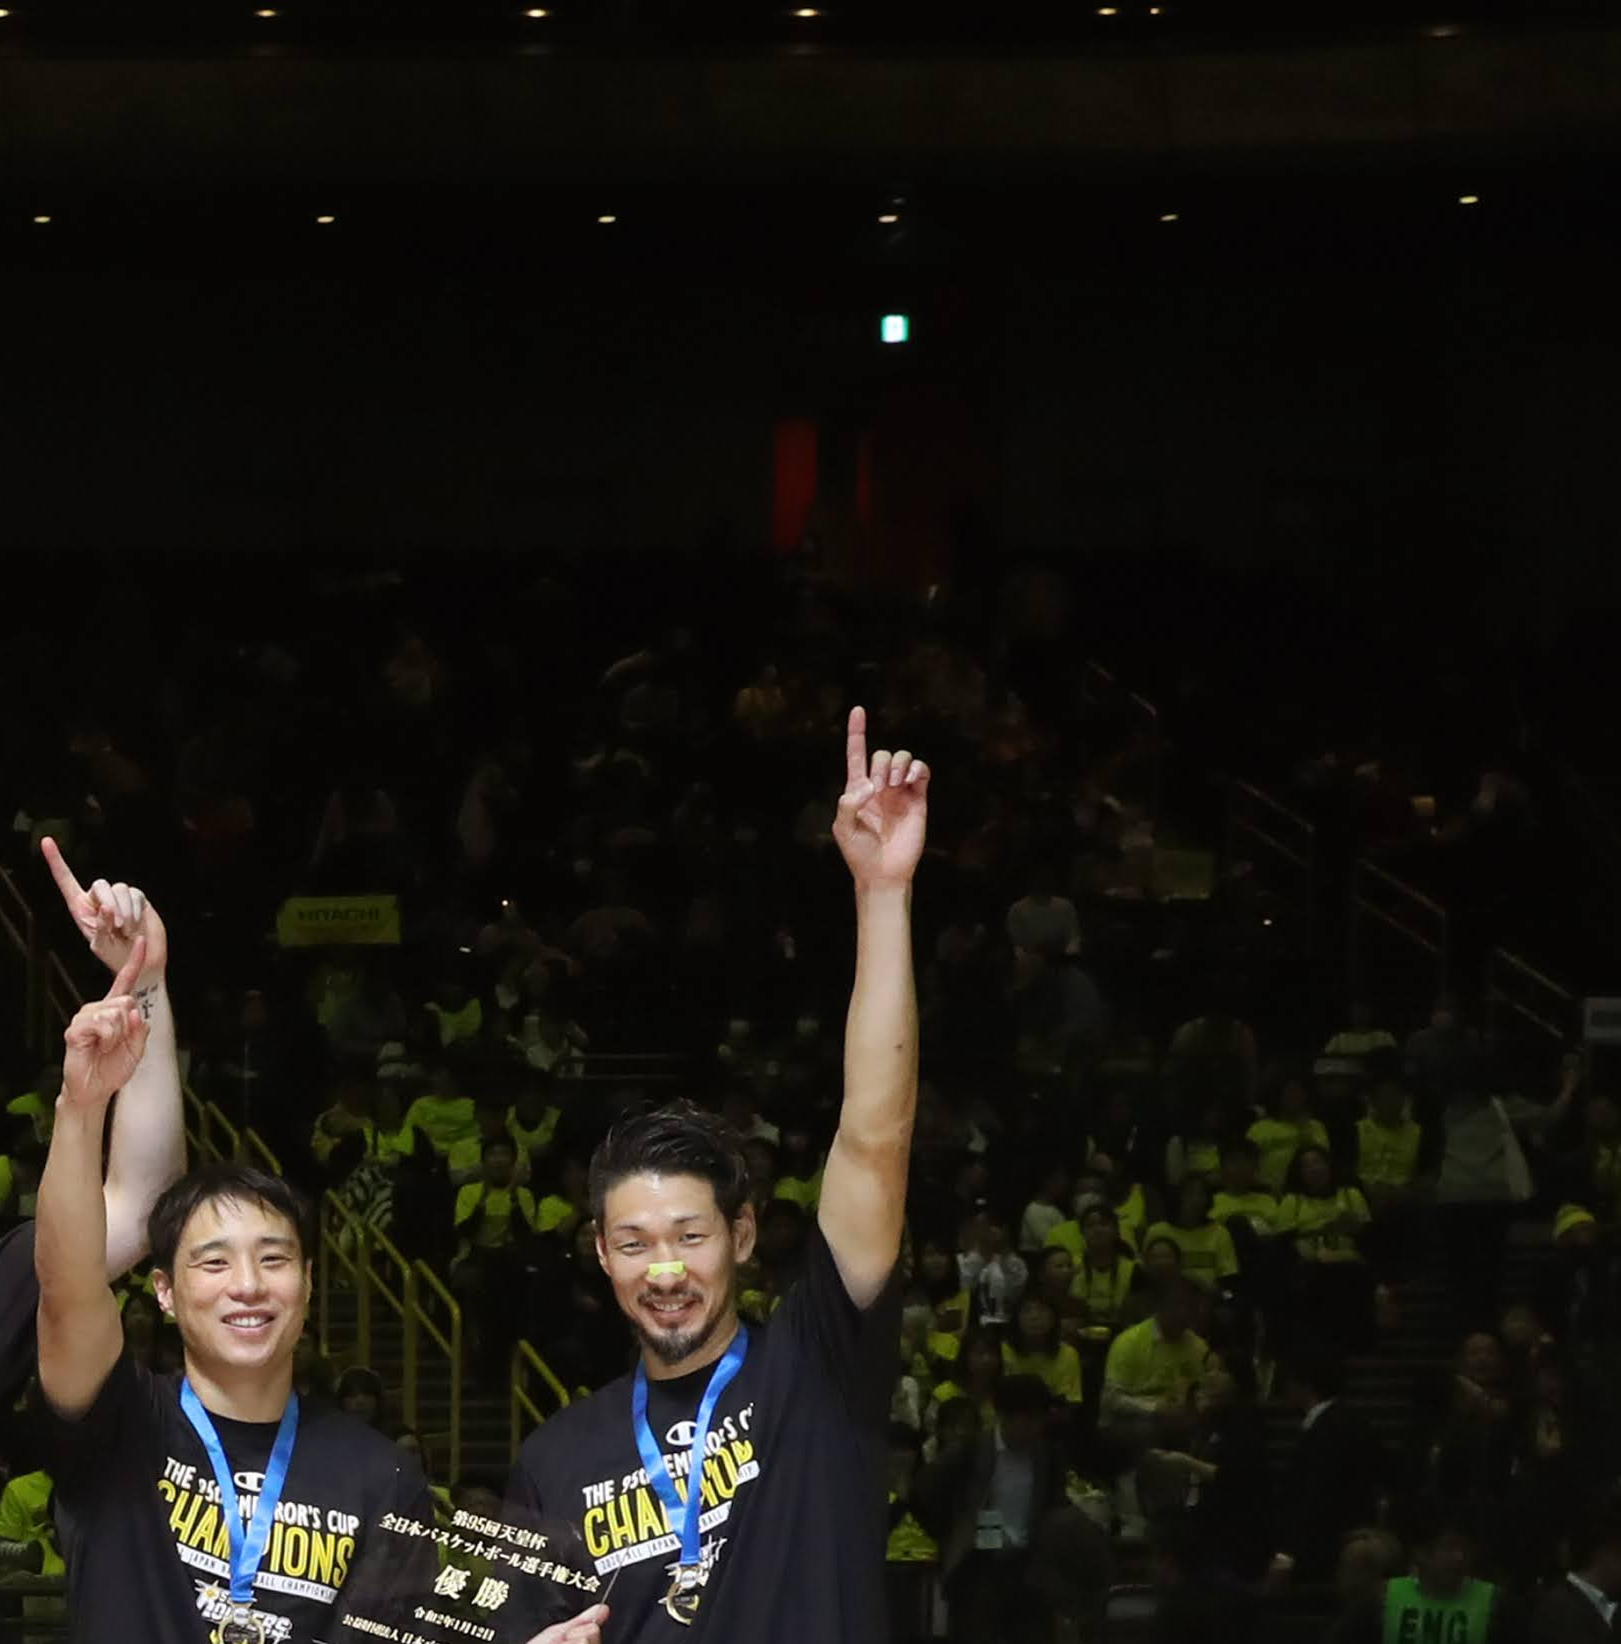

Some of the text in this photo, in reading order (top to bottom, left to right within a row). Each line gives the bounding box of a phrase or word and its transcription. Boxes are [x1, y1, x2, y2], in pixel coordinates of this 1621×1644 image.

[163, 1456, 197, 1484] THE
[327, 1510, 360, 1535] CUP
[582, 1480, 615, 1509] THE
[452, 1509, 548, 1551] 第95回天皇杯
[648, 1538, 677, 1558] JAPAN
[379, 1512, 601, 1593] 全日本バスケットボール選手権大会
[434, 1565, 509, 1611] 優勝
[414, 1606, 495, 1641] 令和2年1月12日
